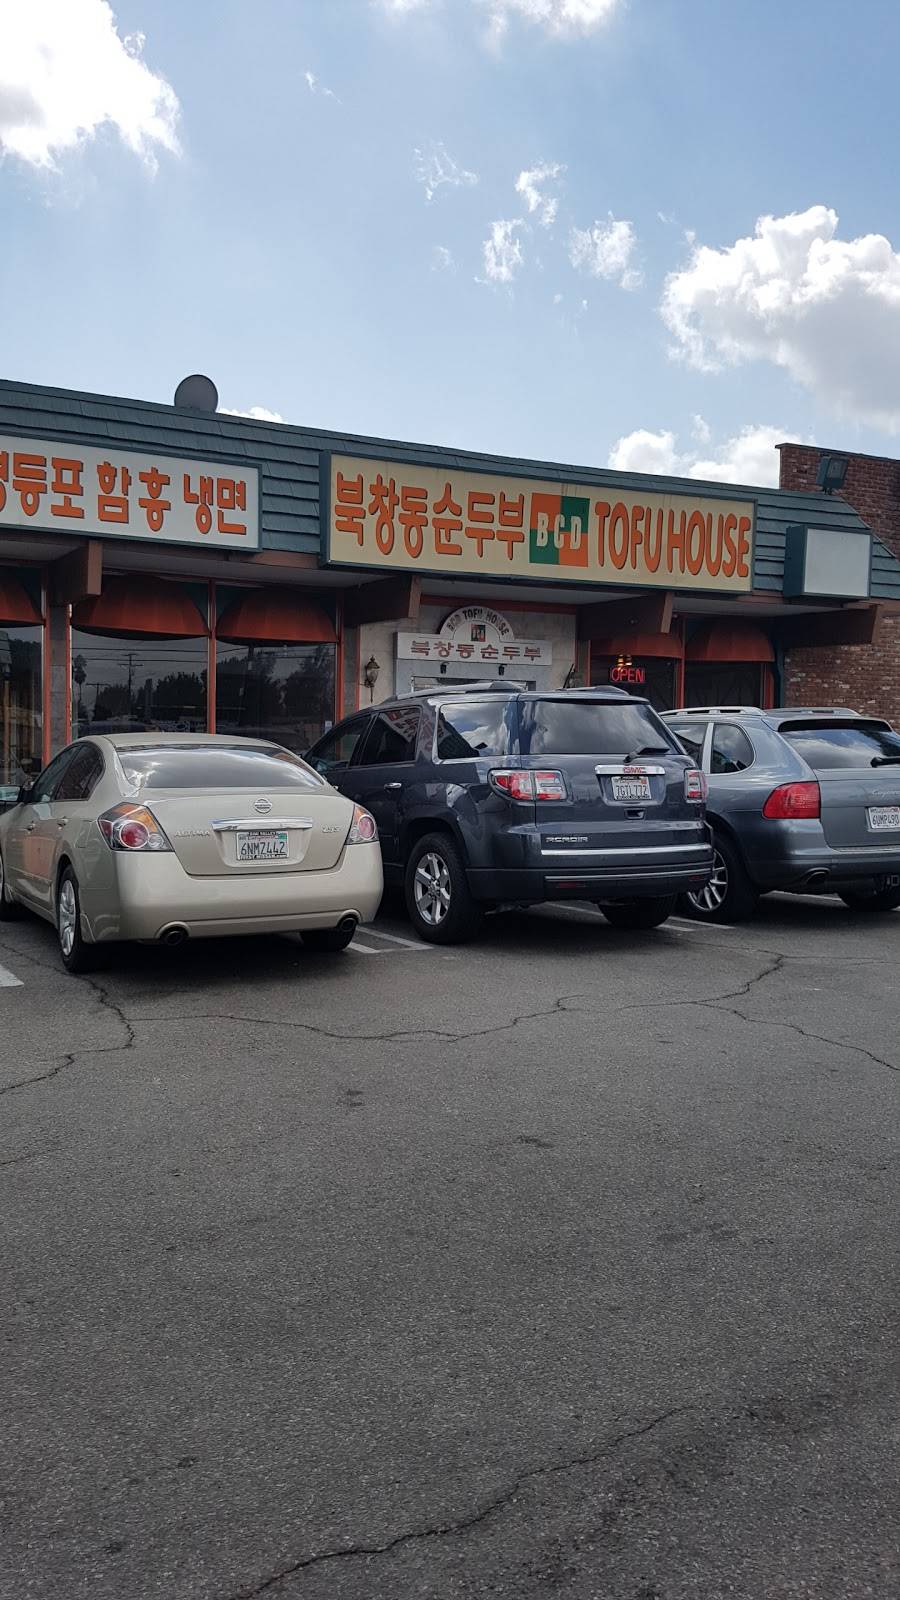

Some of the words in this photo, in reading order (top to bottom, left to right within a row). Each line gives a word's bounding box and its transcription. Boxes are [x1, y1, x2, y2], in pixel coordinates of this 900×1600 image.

[97, 461, 171, 532] 함흥
[183, 473, 247, 536] 냉면
[335, 471, 525, 561] 북창동순두부
[536, 512, 582, 550] BCD
[594, 501, 663, 573] TOFU
[667, 508, 751, 578] HOUSE
[462, 608, 483, 620] TOFU
[410, 640, 542, 661] 북창동순두부
[611, 667, 644, 683] OPEN
[240, 842, 286, 855] 6NMZ442
